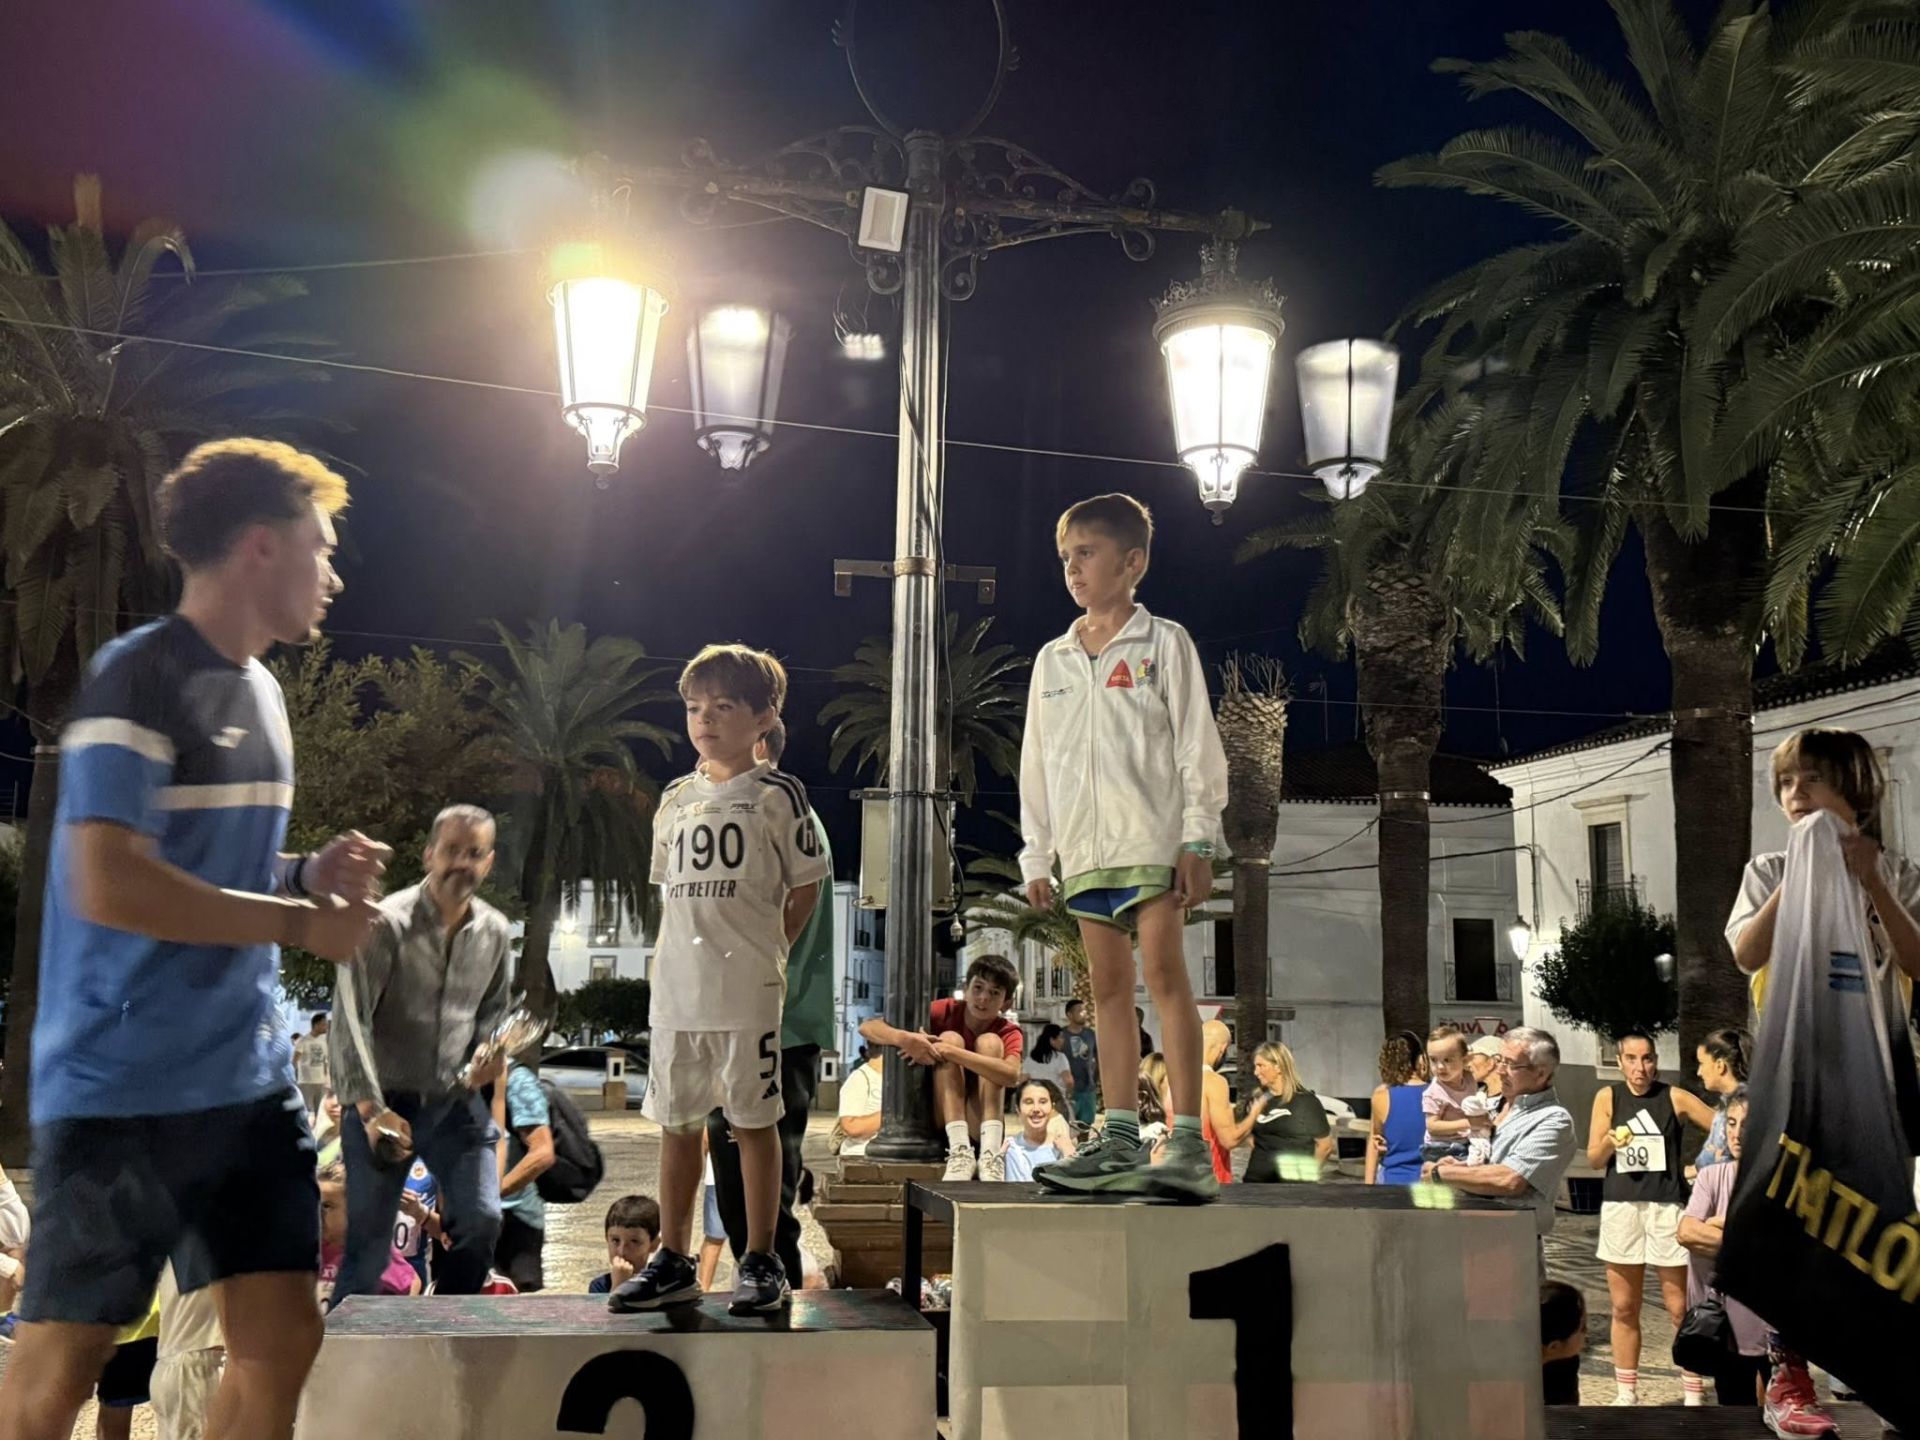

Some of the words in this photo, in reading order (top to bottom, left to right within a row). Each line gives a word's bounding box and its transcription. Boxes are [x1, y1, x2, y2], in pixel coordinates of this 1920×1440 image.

[674, 822, 745, 873] 190
[688, 880, 737, 899] BETTER
[758, 1030, 778, 1080] 5
[1626, 1146, 1649, 1166] 89
[1189, 1242, 1294, 1440] 1
